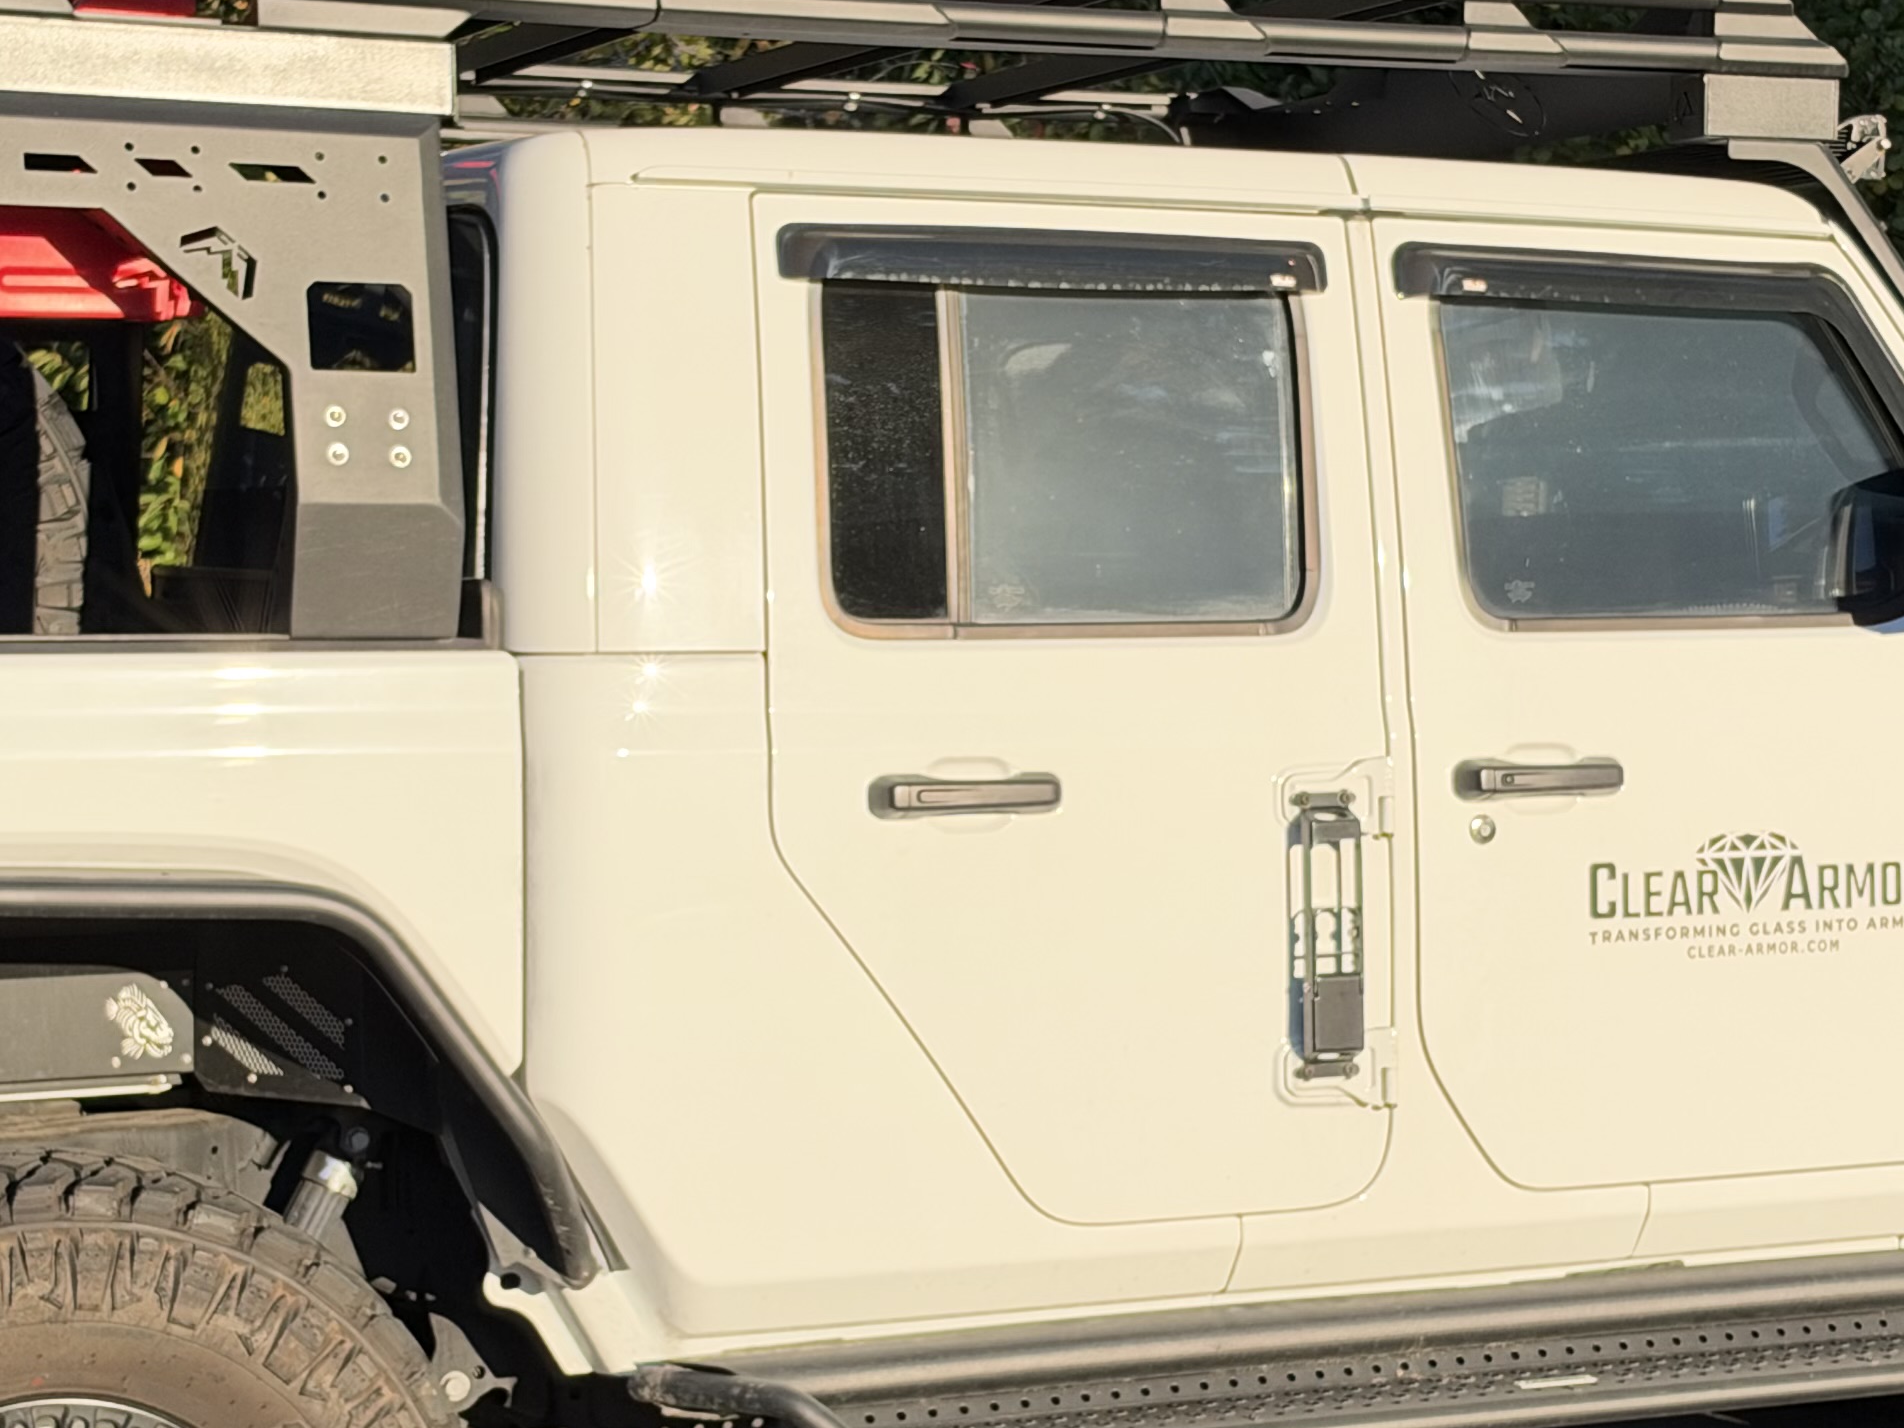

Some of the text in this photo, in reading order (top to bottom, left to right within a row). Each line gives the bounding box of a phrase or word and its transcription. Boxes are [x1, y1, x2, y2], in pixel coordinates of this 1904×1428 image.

[1589, 862, 1721, 919] CLEAR
[1589, 923, 1741, 945] TRANSFORMING
[1749, 920, 1807, 936] GLASS
[1815, 917, 1858, 933] INTO
[1687, 939, 1840, 960] CLEAR-ARMOR.COM
